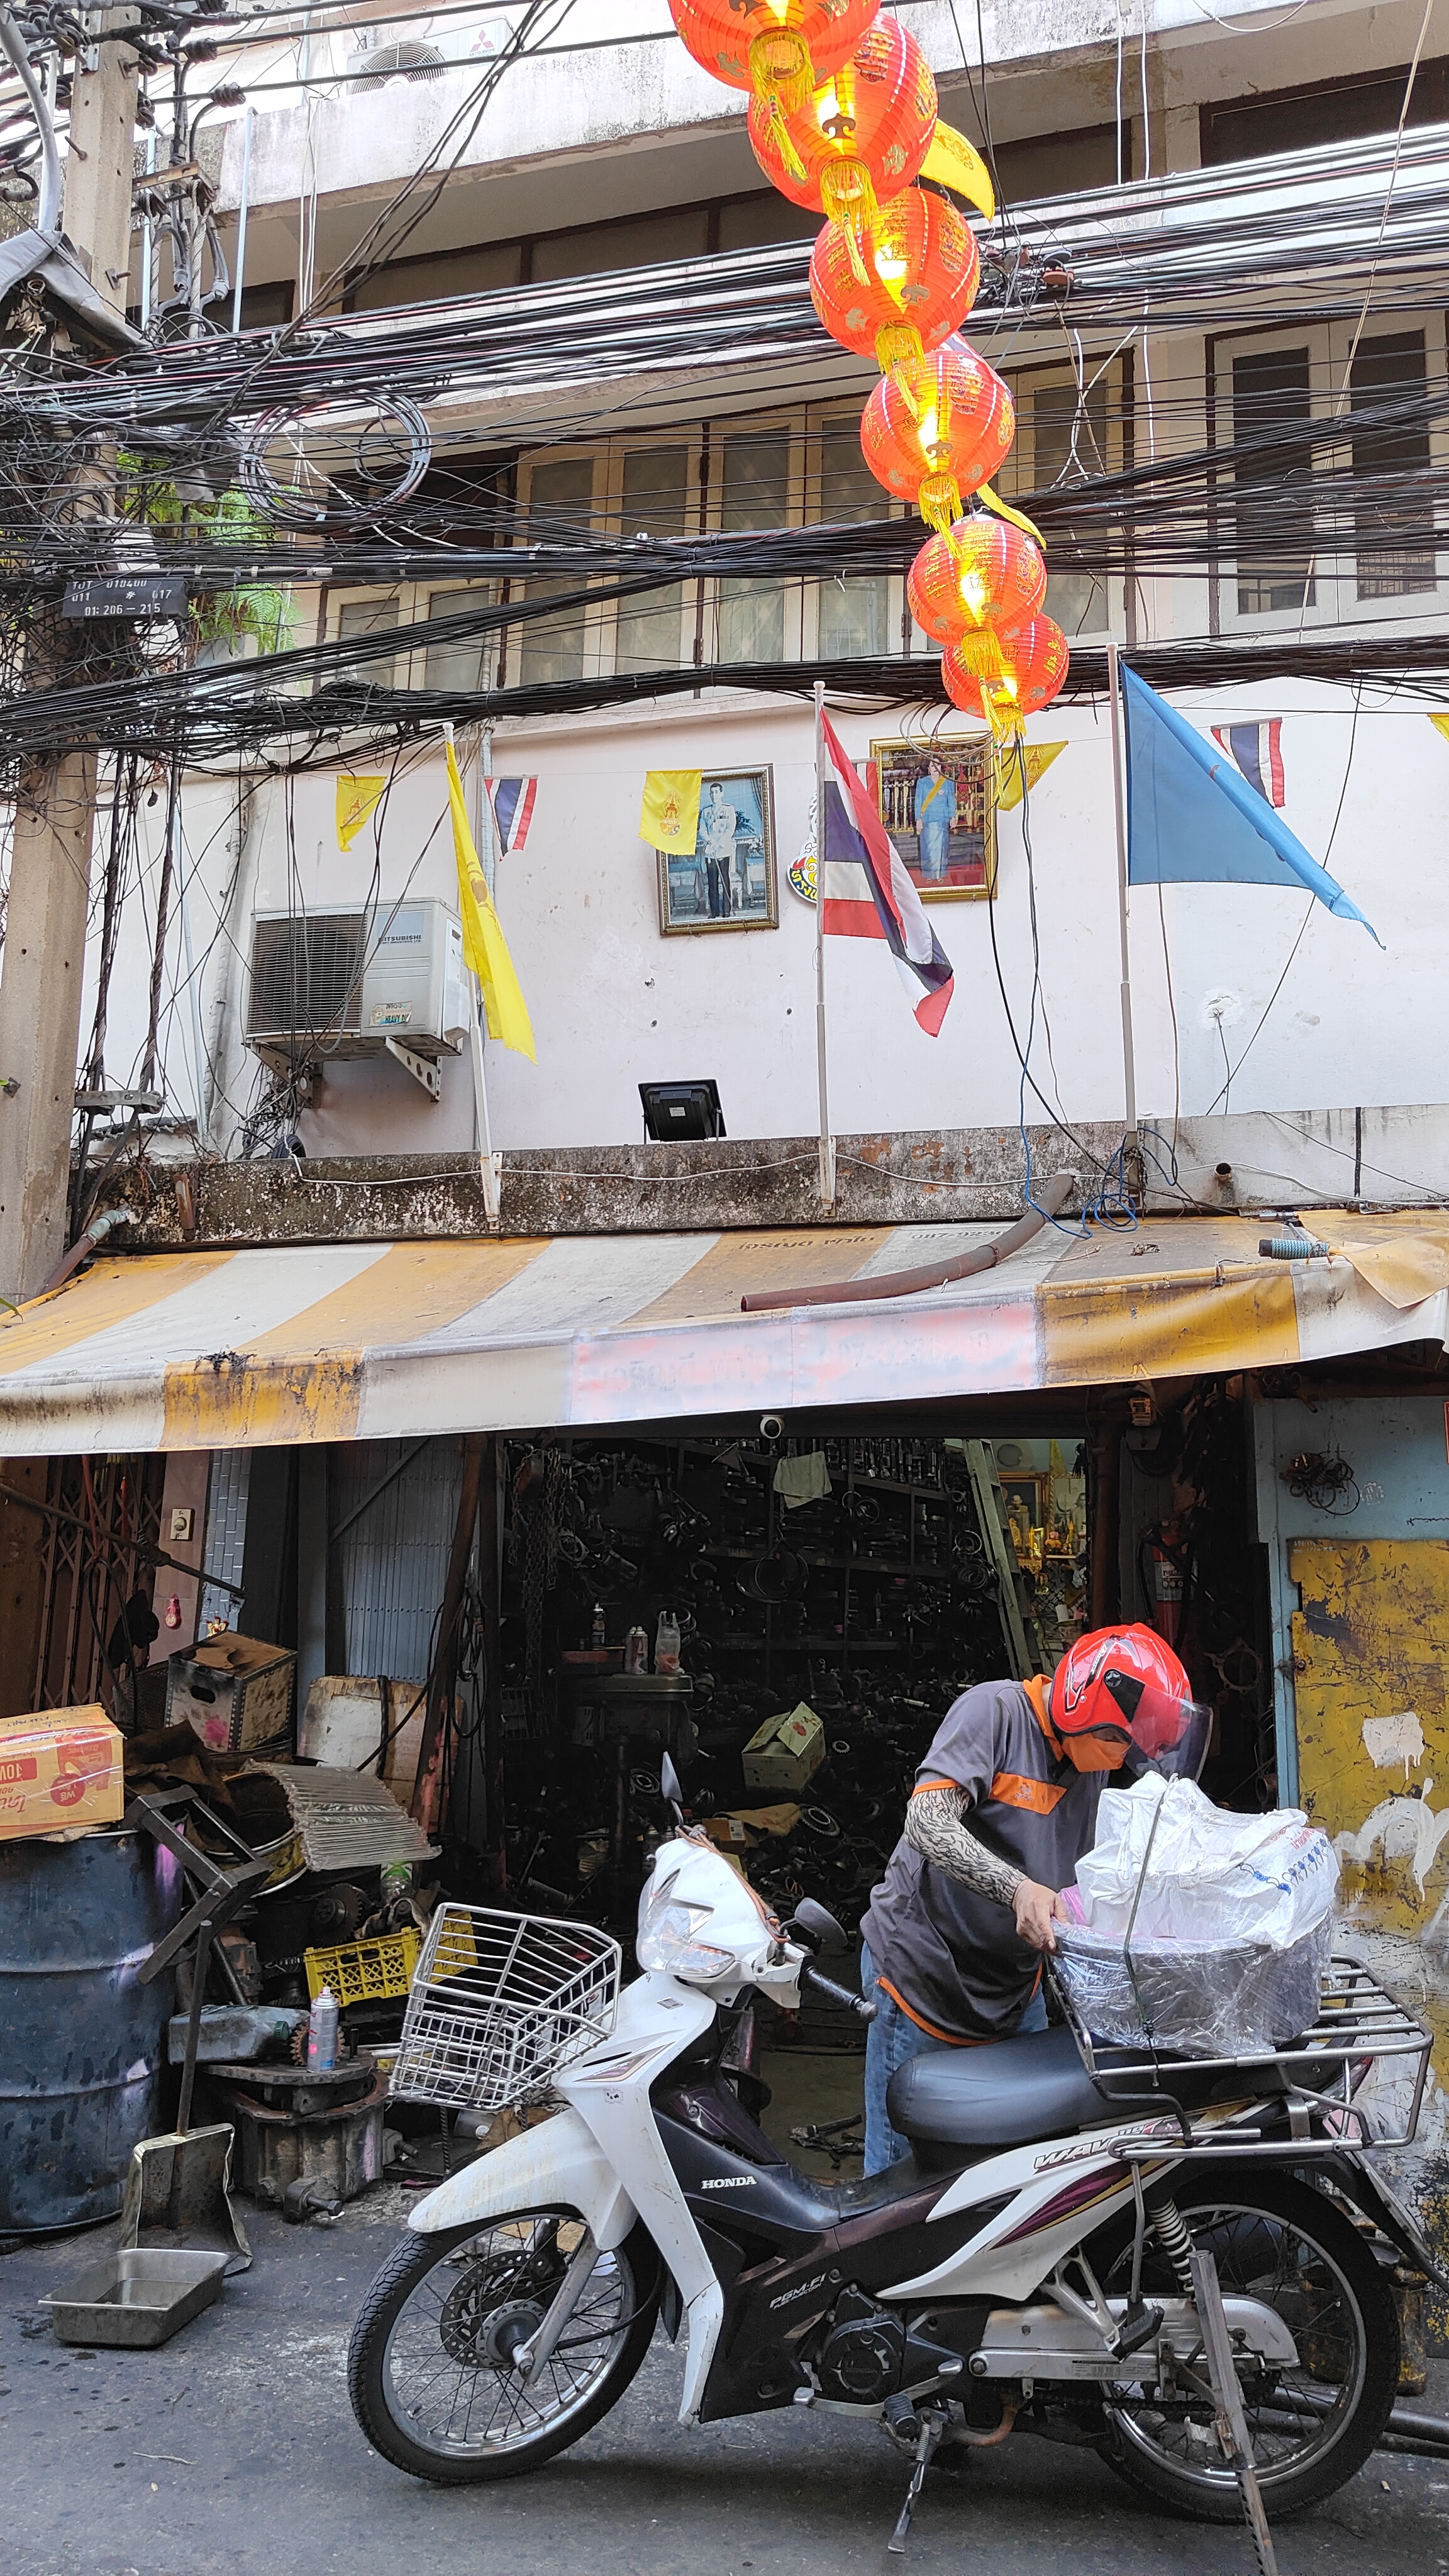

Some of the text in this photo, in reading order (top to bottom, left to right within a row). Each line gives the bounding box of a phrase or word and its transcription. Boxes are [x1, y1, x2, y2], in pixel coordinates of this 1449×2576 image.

[103, 604, 123, 615] 206
[139, 603, 162, 614] 215
[1034, 2138, 1111, 2170] WAV
[701, 2175, 757, 2189] HONDA
